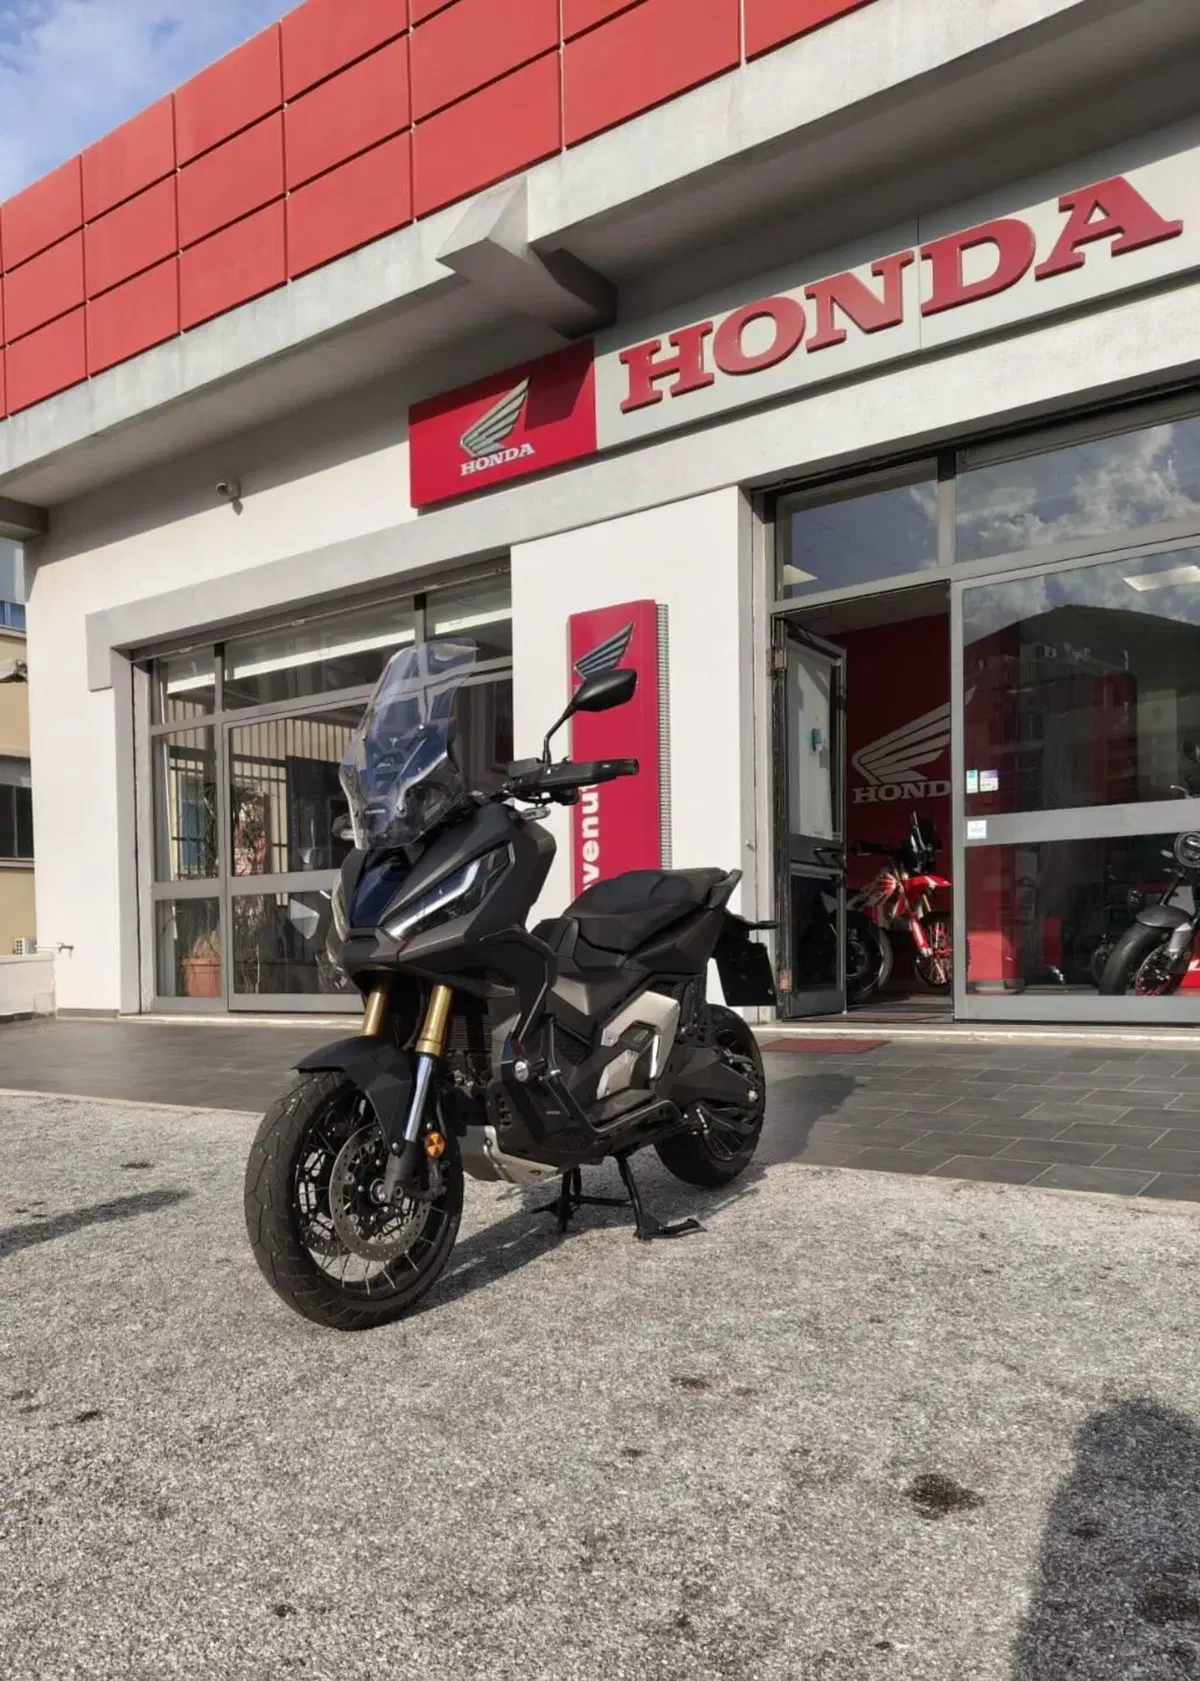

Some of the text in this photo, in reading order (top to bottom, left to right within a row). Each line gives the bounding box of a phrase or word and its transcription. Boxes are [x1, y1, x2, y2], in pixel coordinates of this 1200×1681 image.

[619, 175, 1184, 413] HONDA
[460, 443, 535, 476] HONDA
[852, 780, 953, 803] HOND
[579, 784, 600, 891] venu
